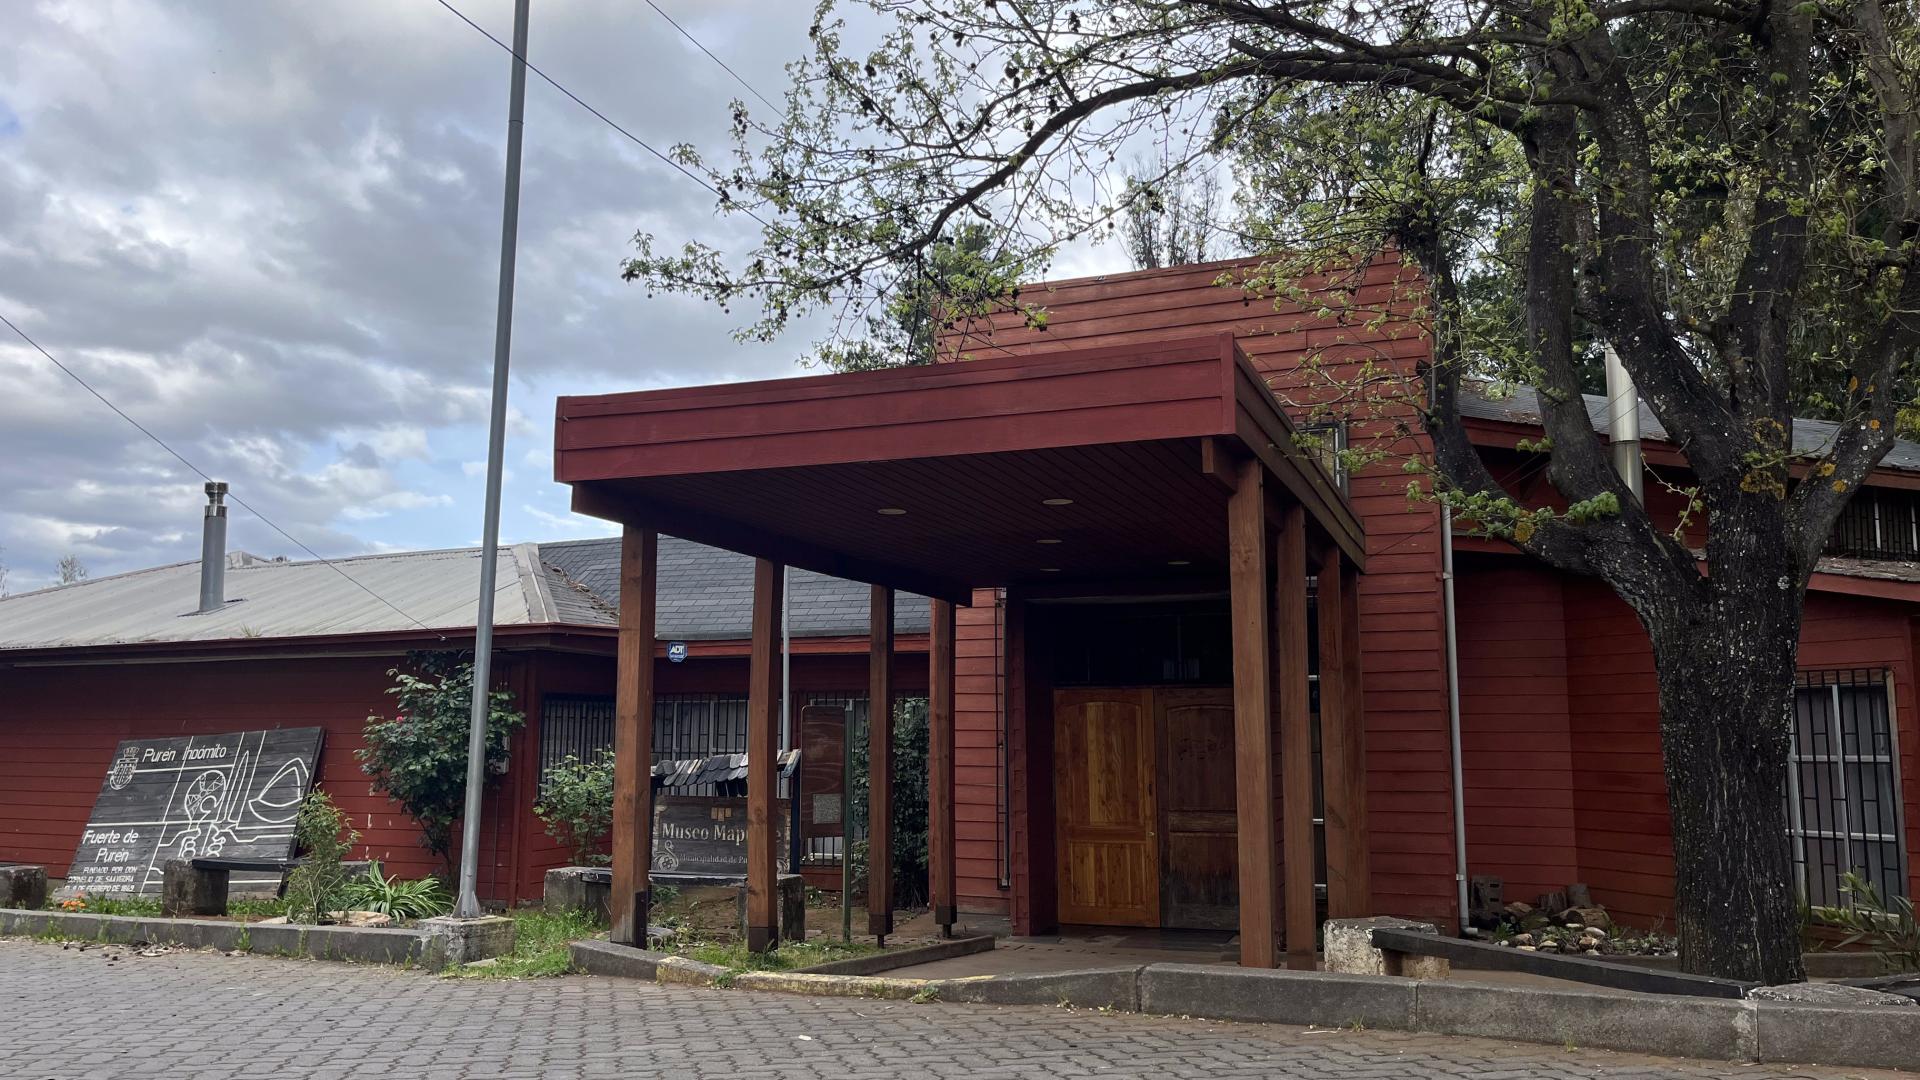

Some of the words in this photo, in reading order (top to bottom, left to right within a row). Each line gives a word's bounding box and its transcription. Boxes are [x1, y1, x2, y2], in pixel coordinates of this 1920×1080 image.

[669, 645, 684, 654] ADT
[142, 748, 176, 762] Purén
[82, 829, 121, 845] Fuerte
[122, 828, 139, 844] de
[662, 822, 709, 840] Museo
[94, 847, 130, 863] Purén
